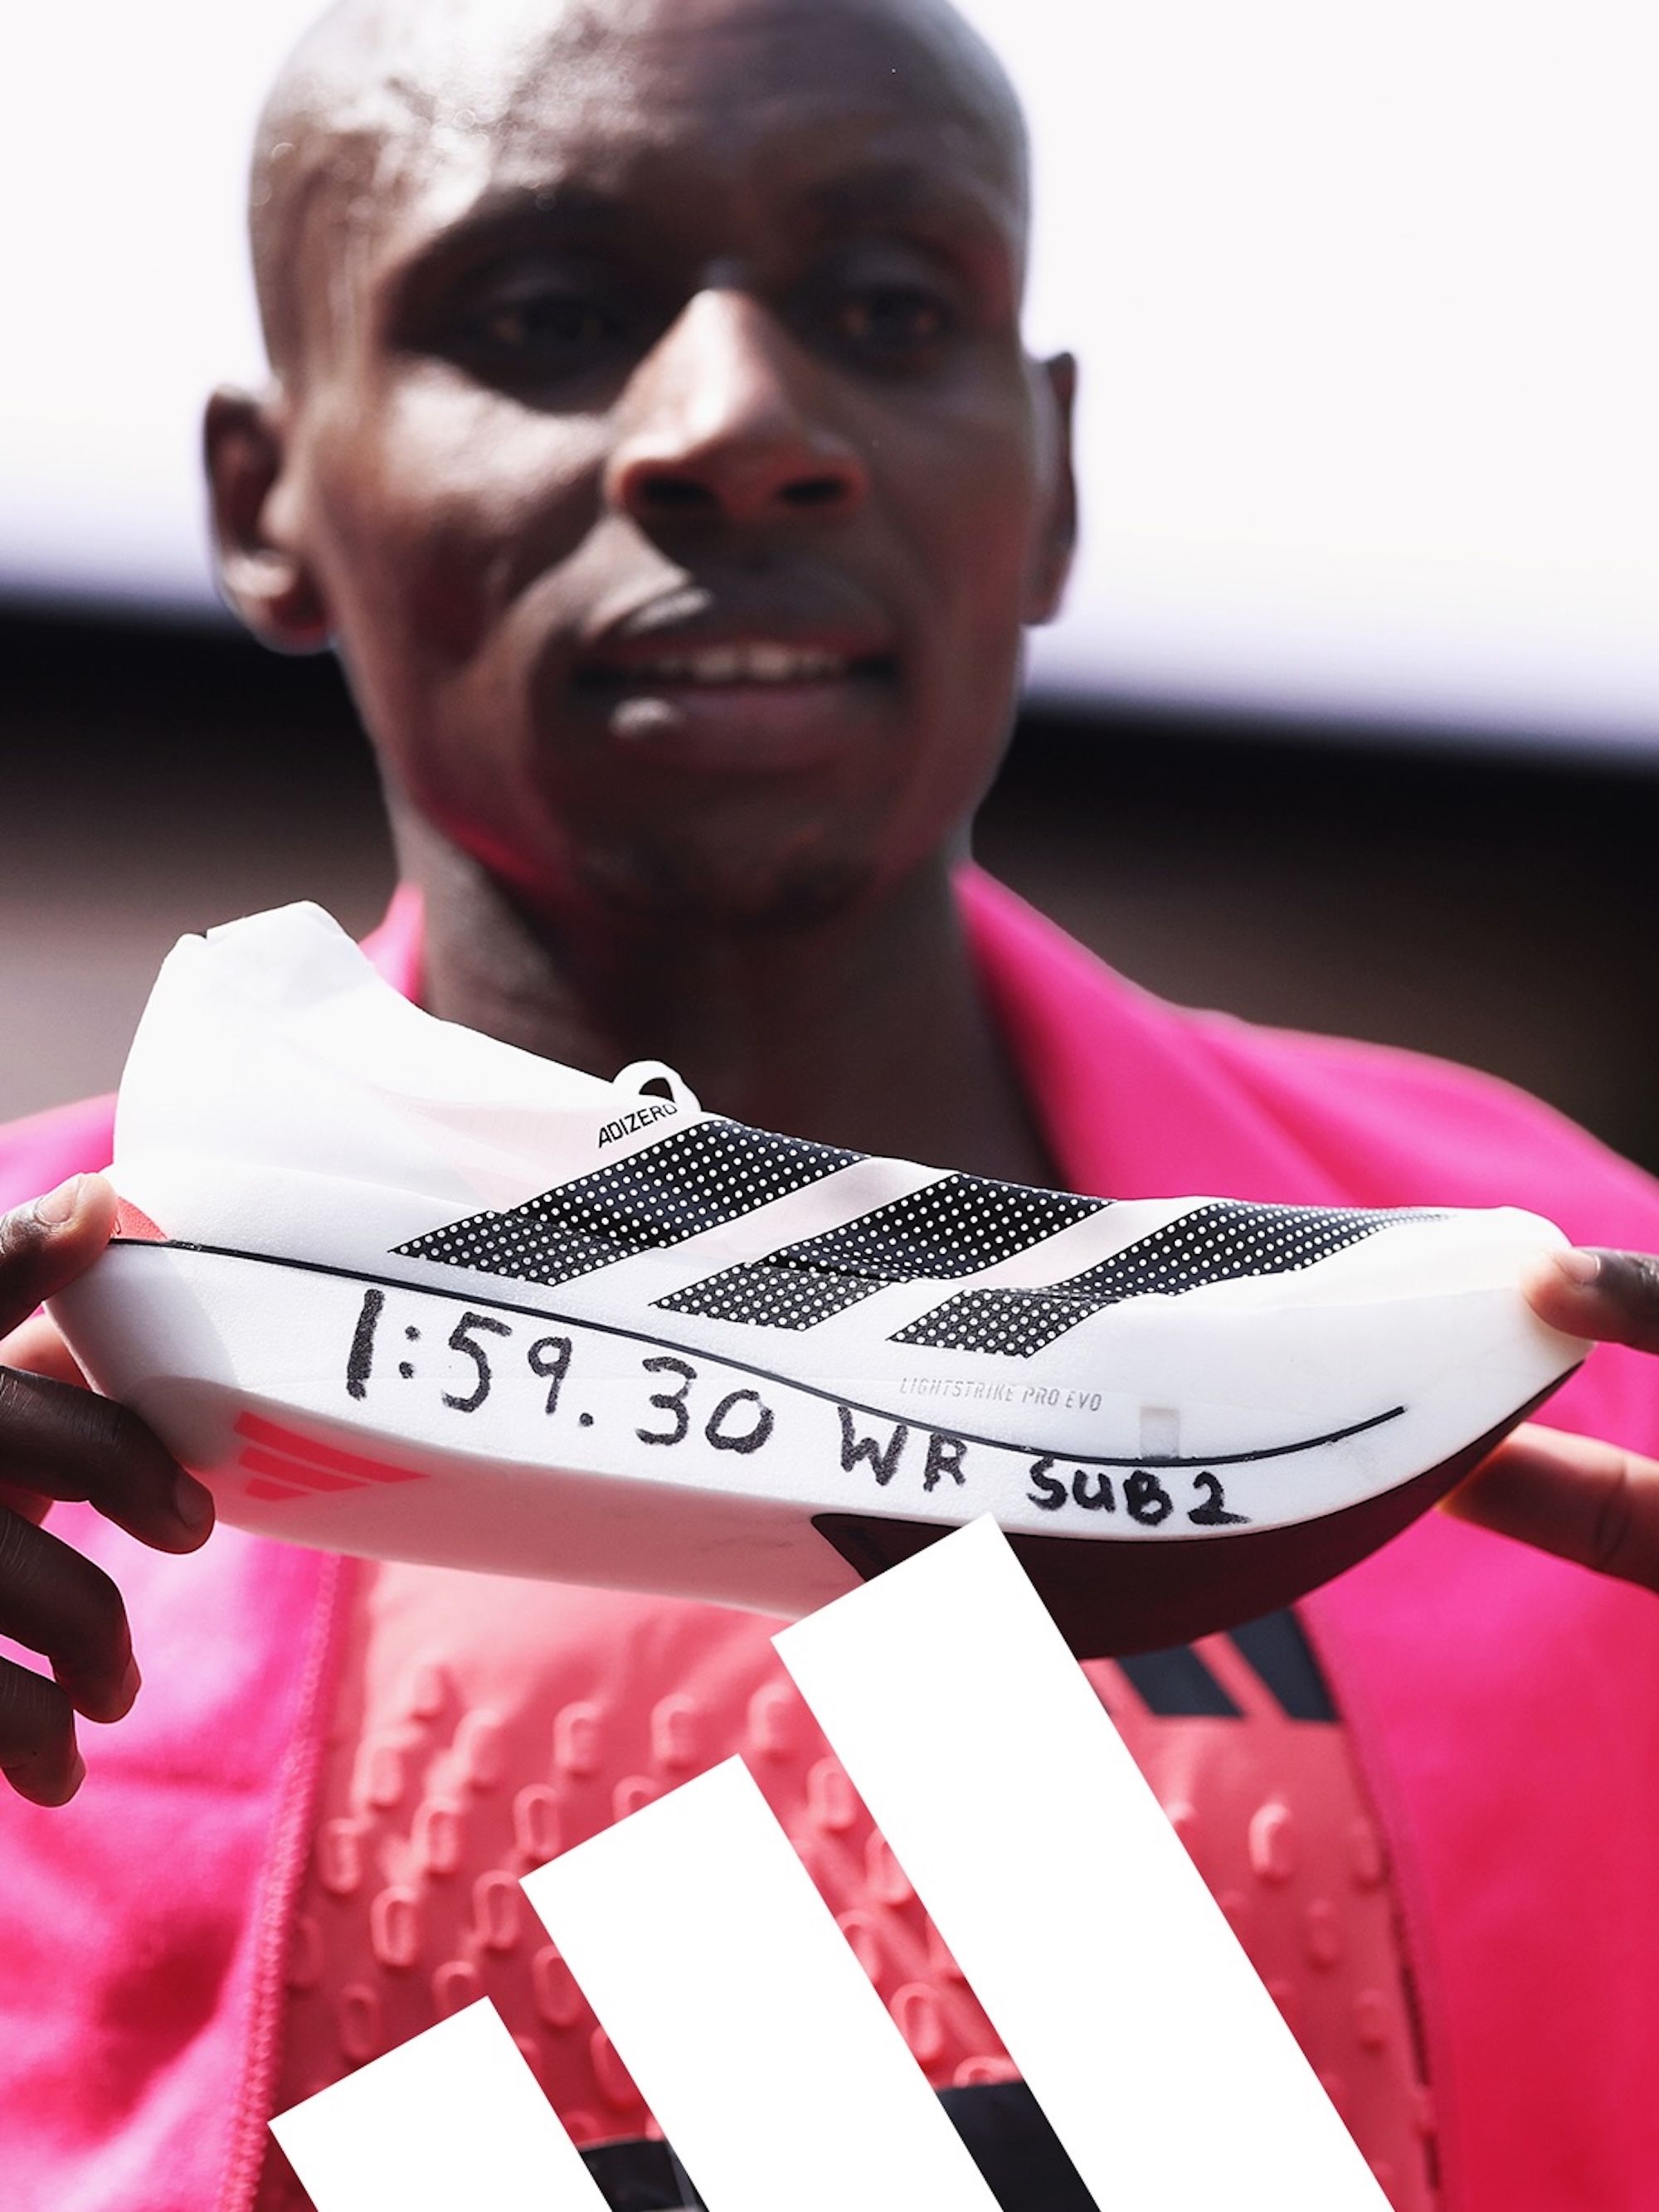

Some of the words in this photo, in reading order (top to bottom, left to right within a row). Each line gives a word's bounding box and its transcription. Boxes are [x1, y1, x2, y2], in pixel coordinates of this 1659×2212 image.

[599, 1103, 678, 1149] ADIZERO
[900, 1377, 1014, 1403] LIGHTSTRIKE
[1022, 1388, 1059, 1407] PRO
[1066, 1391, 1103, 1412] EVO
[838, 1407, 968, 1492] WR
